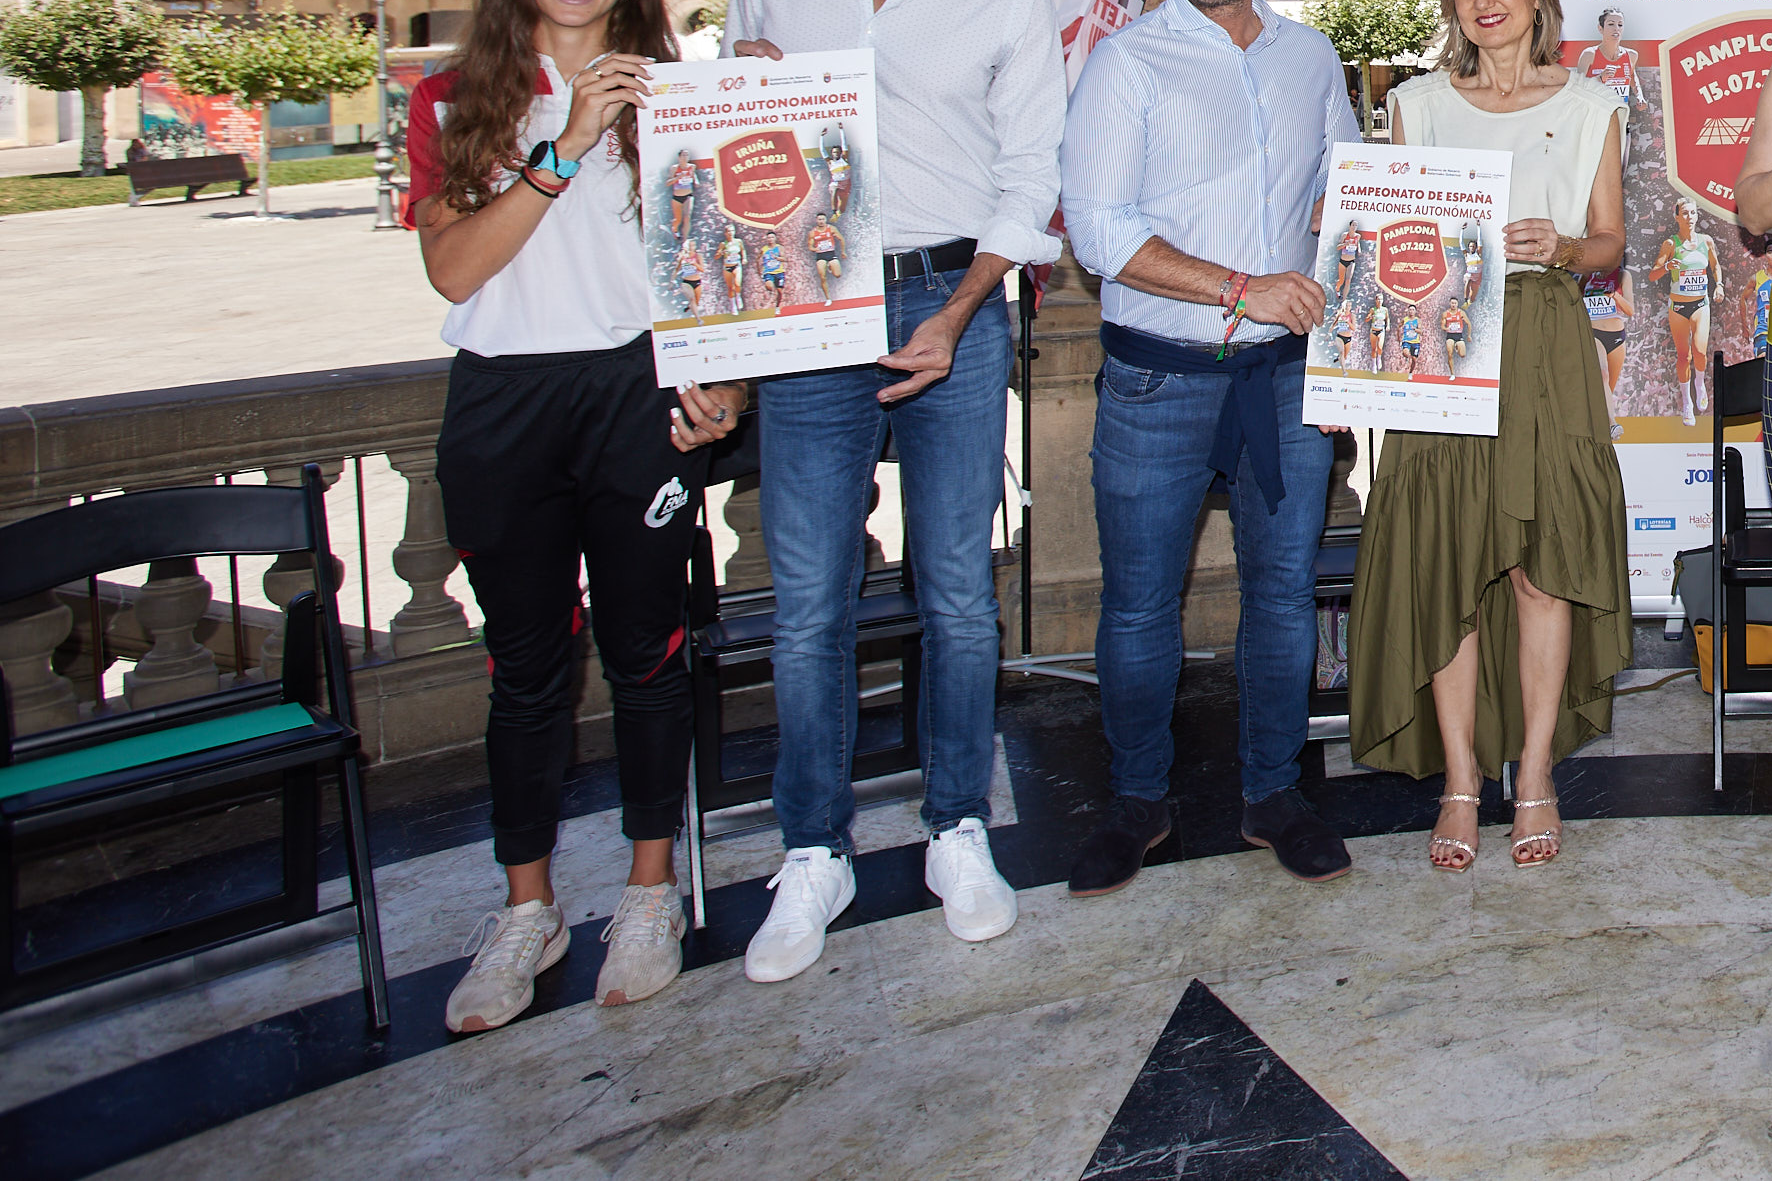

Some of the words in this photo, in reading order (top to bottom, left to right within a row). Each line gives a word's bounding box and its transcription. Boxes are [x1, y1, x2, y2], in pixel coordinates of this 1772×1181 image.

[654, 104, 732, 119] FEDERAZIO
[737, 92, 858, 112] AUTONOMIKOEN
[653, 122, 702, 134] ARTEKO
[706, 115, 779, 130] ESPAINIAKO
[782, 107, 858, 122] TXAPELKETA
[735, 139, 775, 158] IRUÑA
[731, 154, 788, 174] 15.07.2023
[1341, 185, 1425, 200] CAMPEONATO
[1428, 191, 1443, 201] DE
[1446, 190, 1493, 204] ESPAÑA
[1341, 200, 1412, 215] FEDERACIONES
[1414, 205, 1492, 220] AUTONÓMICAS
[1383, 226, 1436, 241] PAMPLONA
[1389, 242, 1434, 255] 15.07.2023
[1683, 277, 1705, 285] AND
[1588, 297, 1612, 307] NAV
